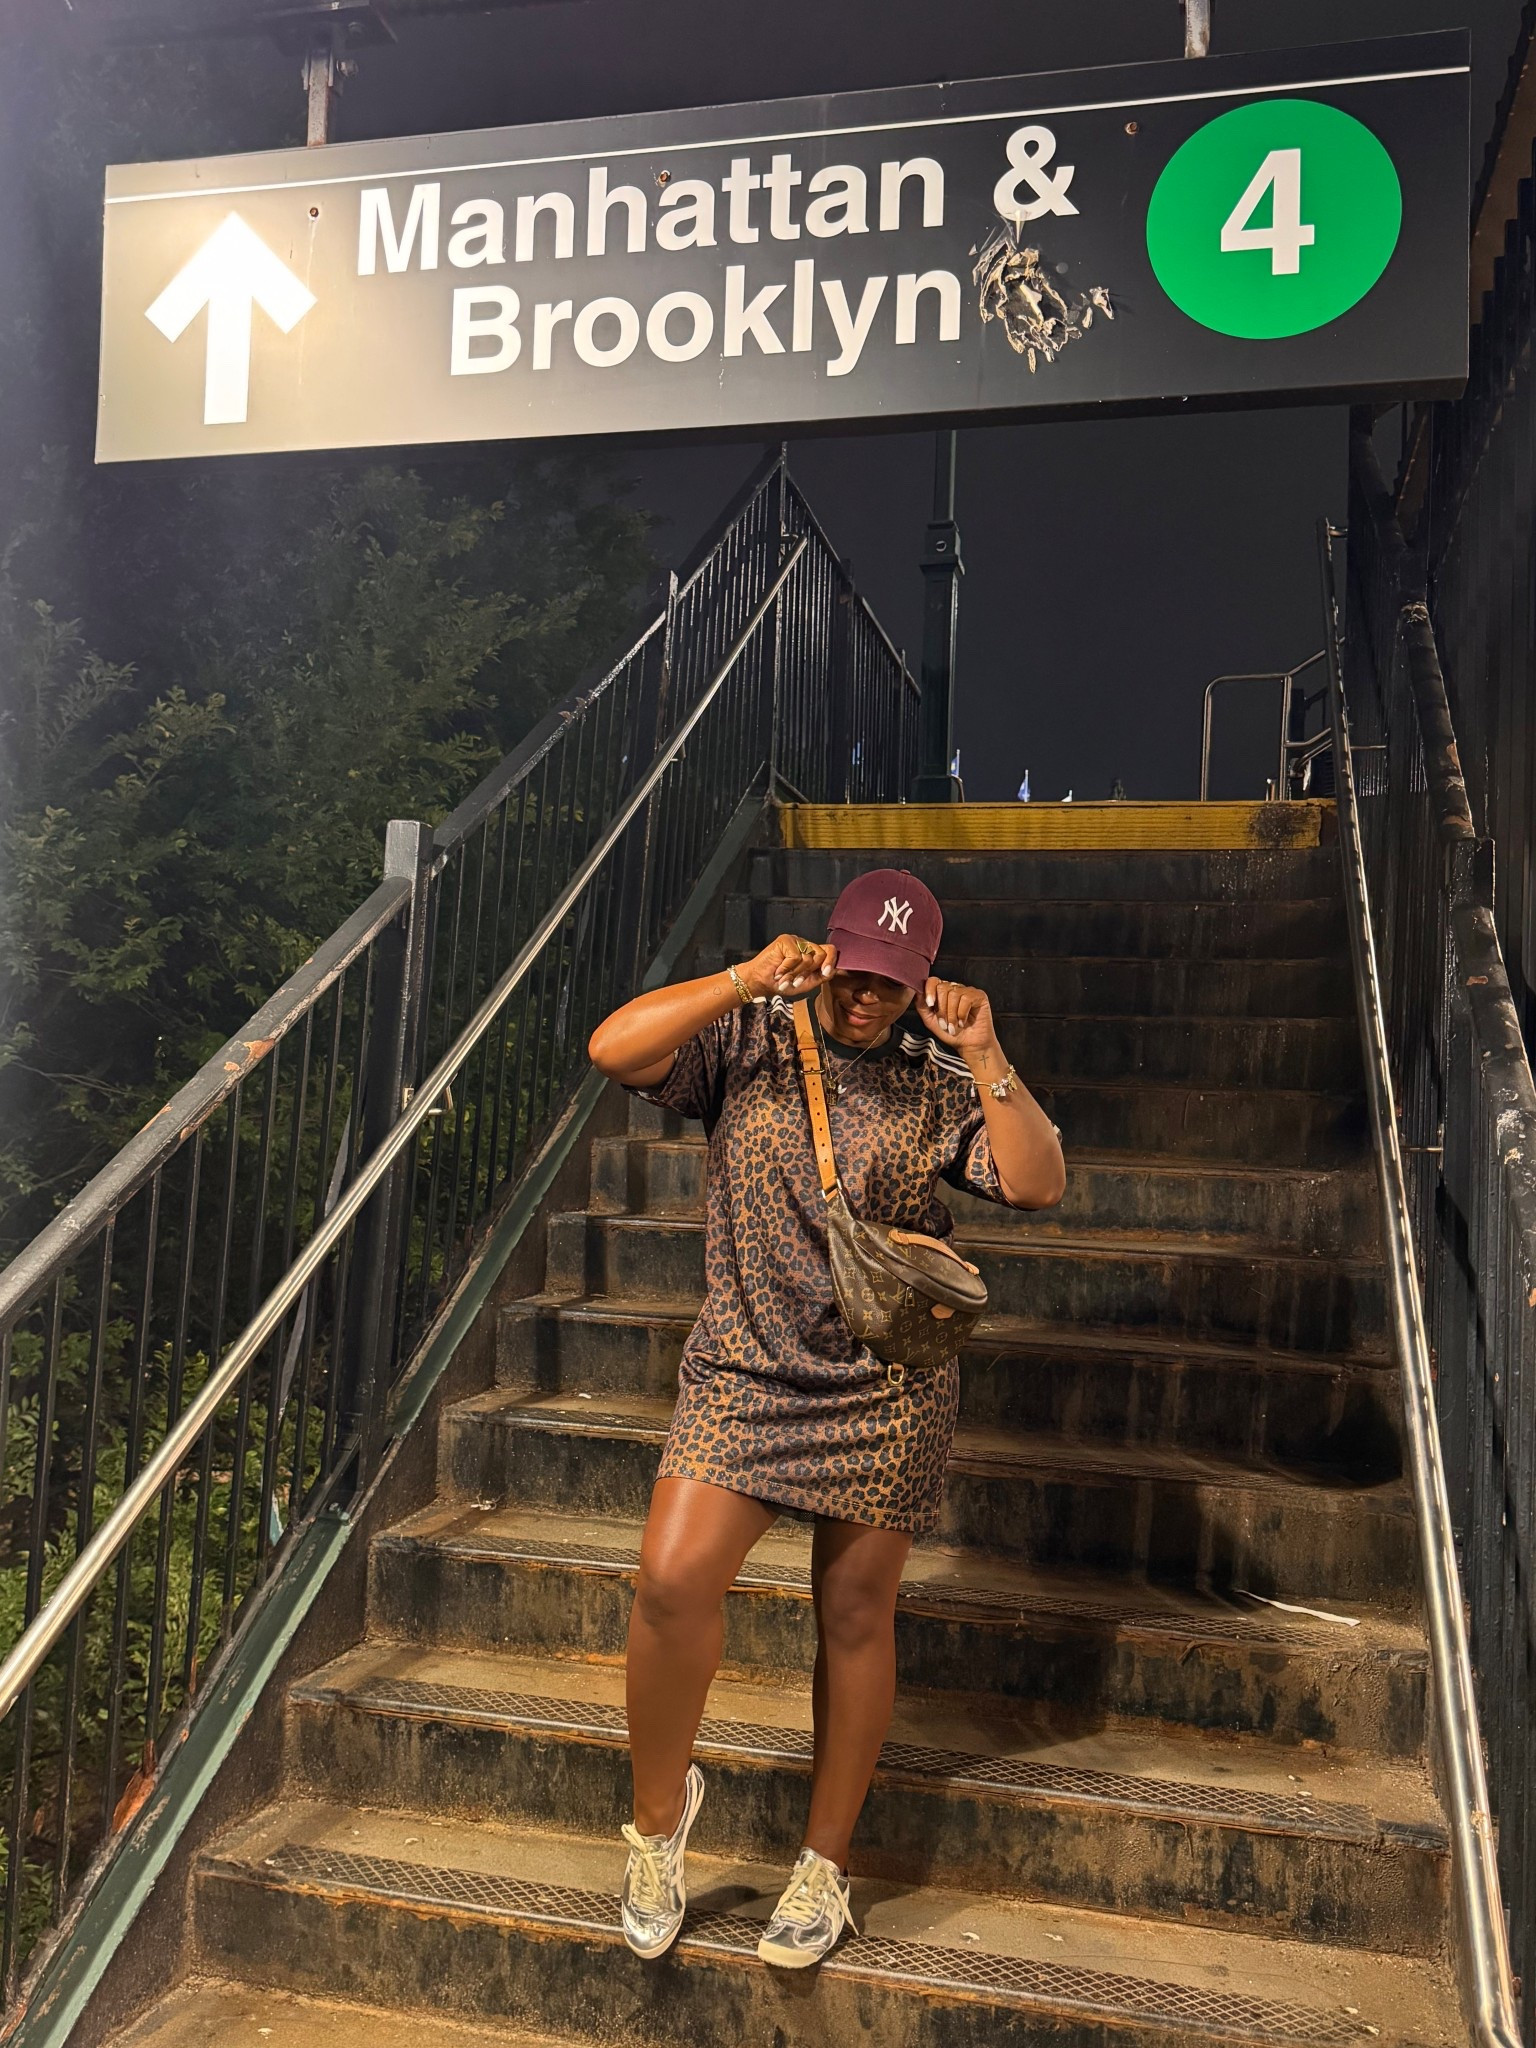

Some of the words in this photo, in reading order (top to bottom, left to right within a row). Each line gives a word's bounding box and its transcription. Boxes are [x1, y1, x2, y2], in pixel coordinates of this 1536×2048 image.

[356, 153, 945, 277] Manhattan
[993, 125, 1080, 222] &
[1220, 148, 1315, 276] 4
[449, 258, 961, 377] Brooklyn
[877, 896, 914, 935] NY
